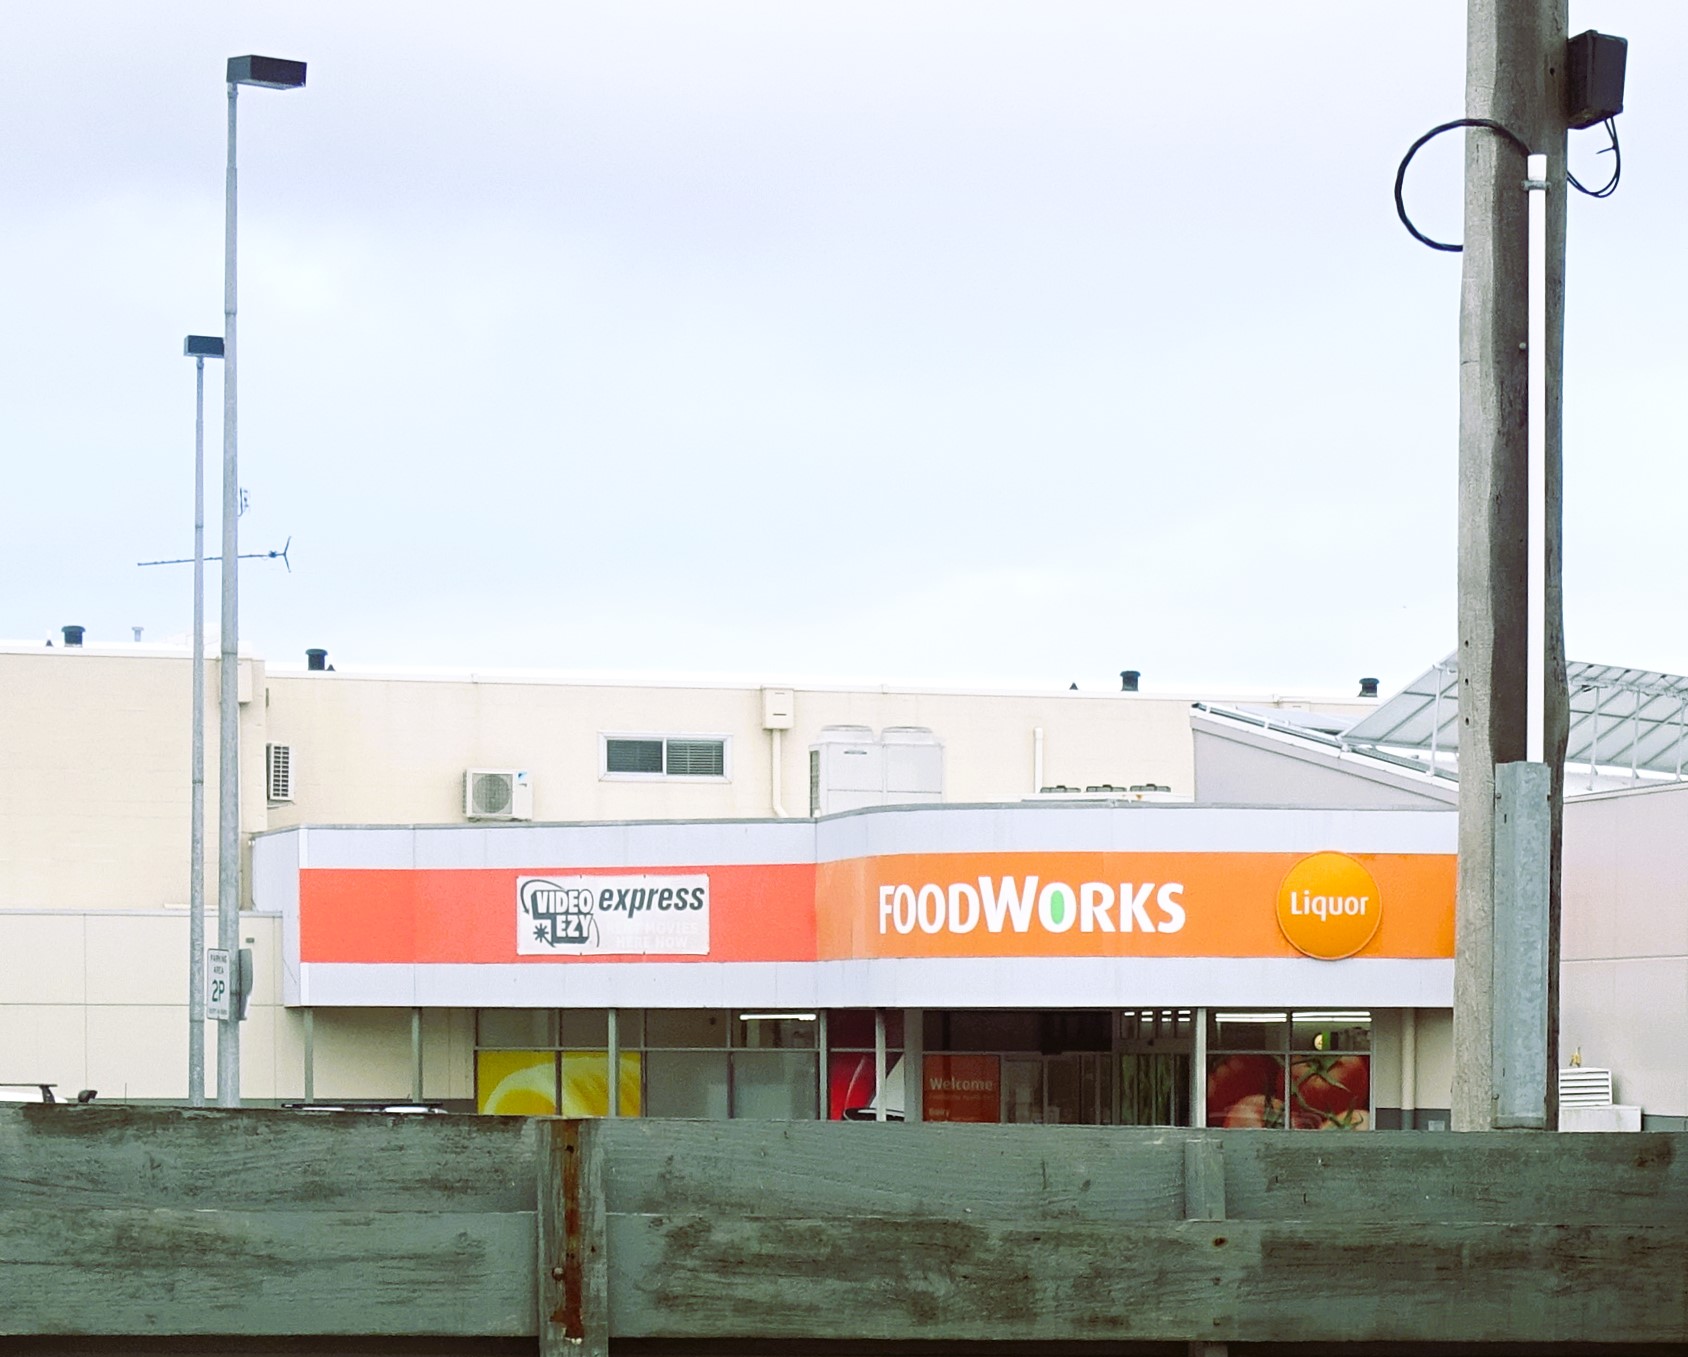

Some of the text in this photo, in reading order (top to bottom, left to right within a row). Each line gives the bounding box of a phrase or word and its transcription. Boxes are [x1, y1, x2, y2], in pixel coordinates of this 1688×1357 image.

[534, 889, 594, 914] VIDEO
[599, 887, 705, 919] express
[879, 875, 1186, 934] FOODWORKS
[1290, 889, 1369, 922] Liquor
[555, 914, 593, 939] EZY
[211, 979, 225, 1002] 2P
[929, 1076, 993, 1091] Welcome
